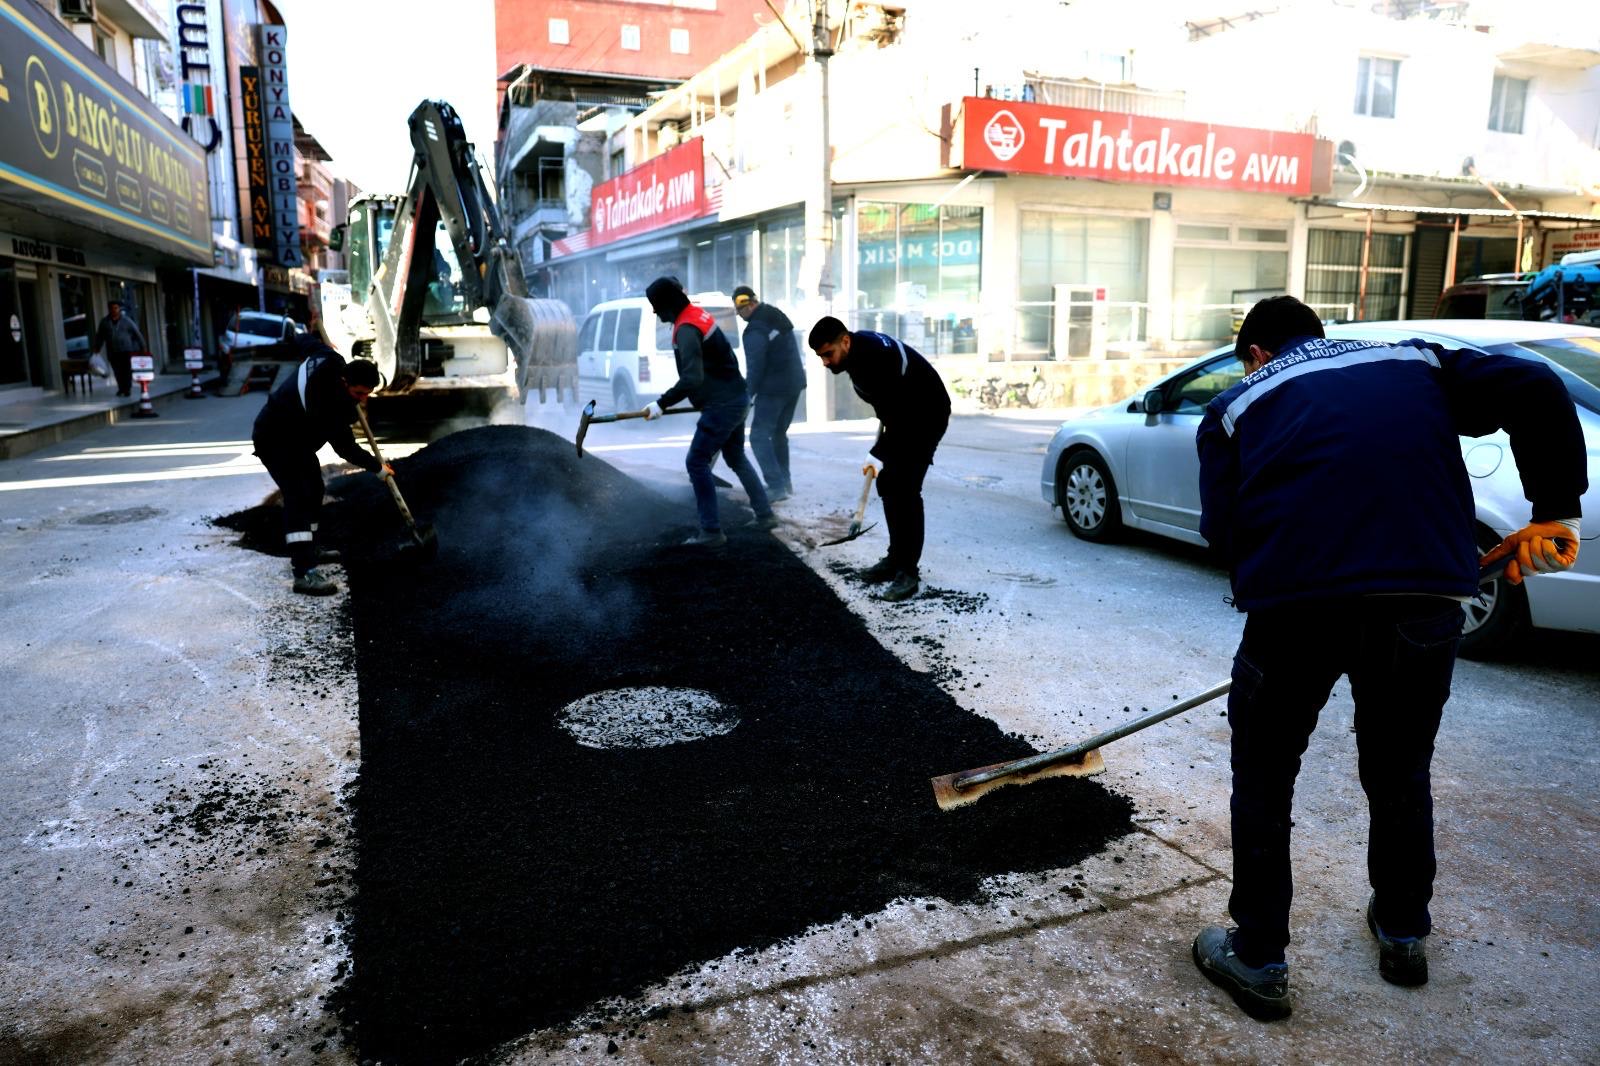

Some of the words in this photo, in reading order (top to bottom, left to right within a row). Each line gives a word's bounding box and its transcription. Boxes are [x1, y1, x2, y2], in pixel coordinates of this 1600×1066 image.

[266, 31, 286, 119] KONYA
[34, 80, 52, 134] B
[61, 80, 144, 174] BAYOĞLU
[1039, 117, 1236, 179] Tahtakale
[1241, 153, 1299, 185] AVM
[253, 195, 270, 238] AVM
[605, 174, 665, 231] Tahtakale
[666, 170, 695, 209] AVM
[1246, 369, 1269, 386] FEN
